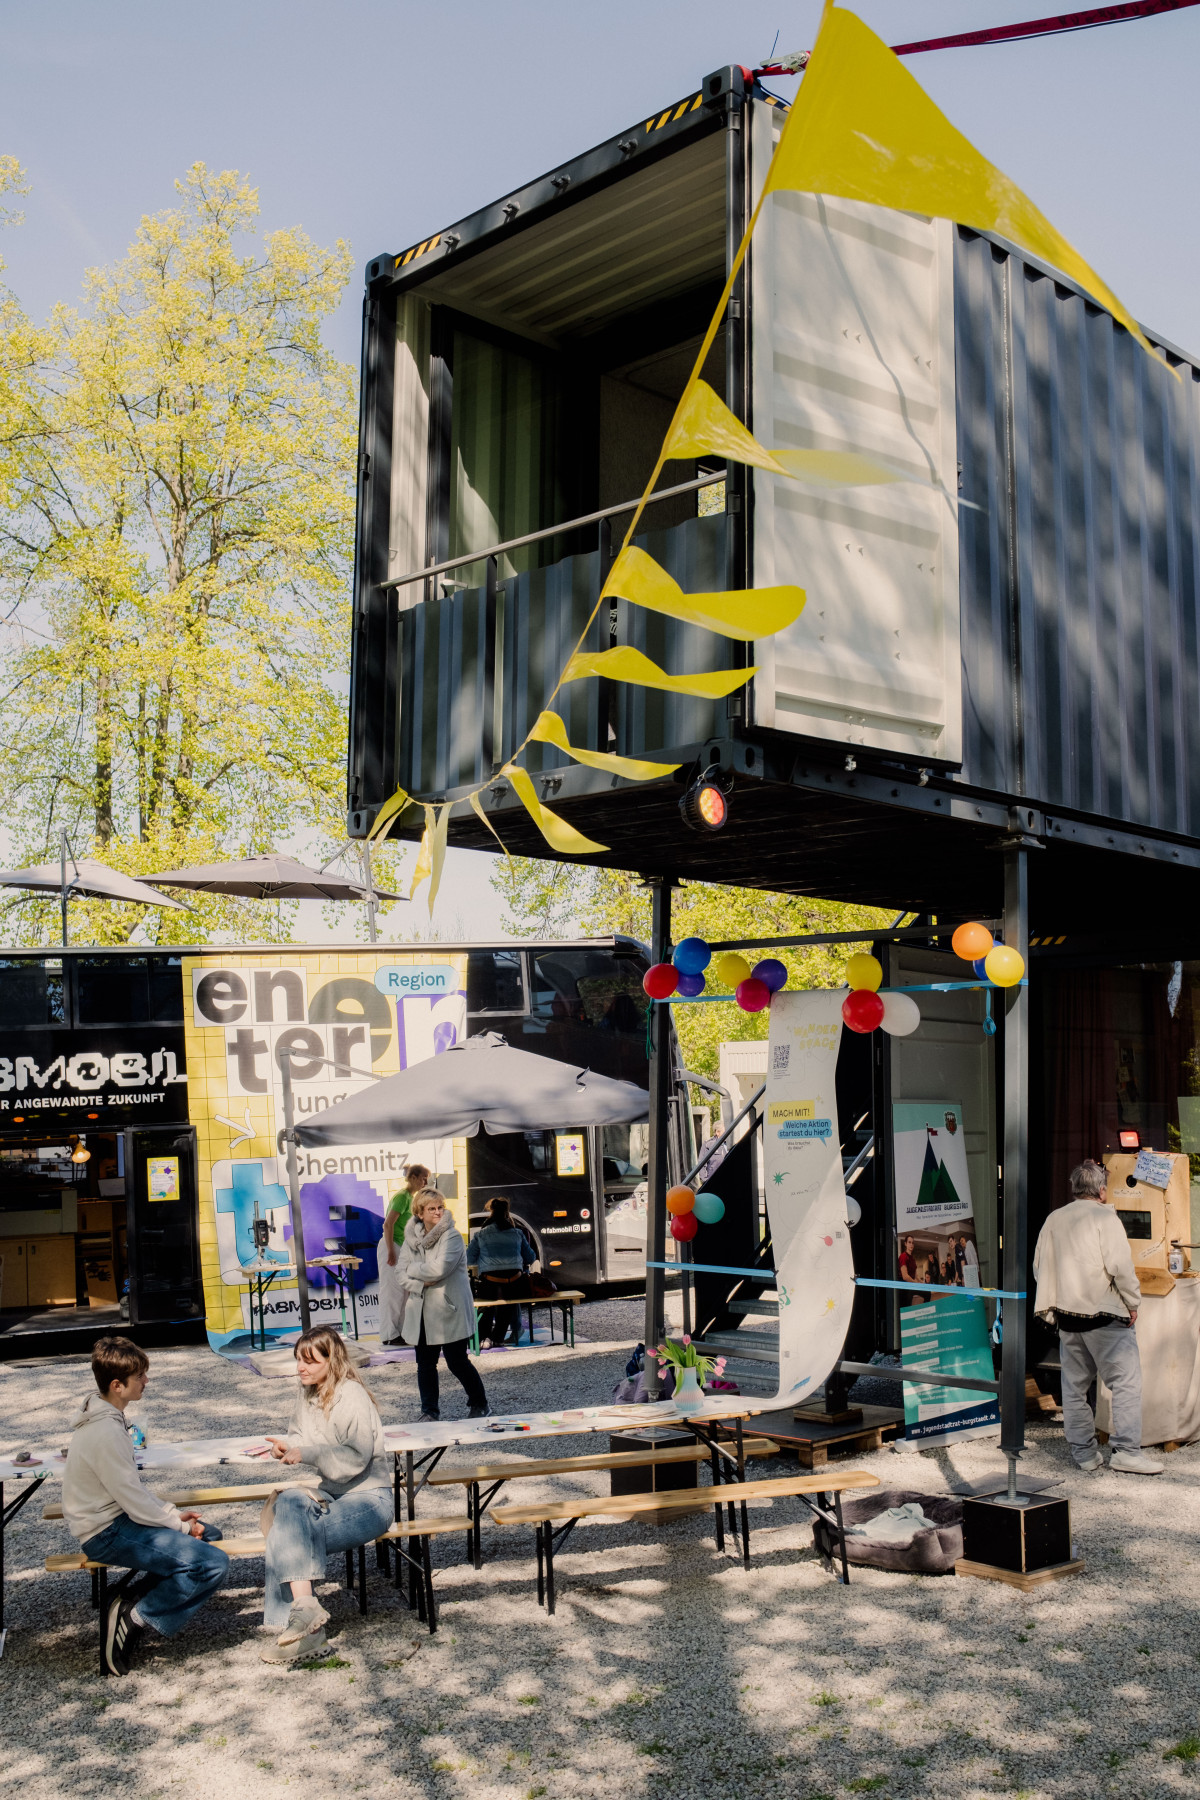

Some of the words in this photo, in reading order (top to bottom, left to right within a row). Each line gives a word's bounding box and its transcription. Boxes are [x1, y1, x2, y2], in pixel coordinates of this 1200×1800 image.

[388, 972, 446, 991] Region
[196, 970, 304, 1023] en
[793, 1024, 839, 1039] WANDER
[228, 1026, 366, 1094] ter
[14, 1096, 104, 1109] ANGEWANDTE
[107, 1093, 166, 1105] ZUKUNFT
[772, 1109, 794, 1118] MACH
[794, 1108, 810, 1117] MIT!
[785, 1121, 808, 1129] Welche
[808, 1120, 829, 1128] Aktion
[779, 1130, 804, 1138] startest
[813, 1128, 830, 1136] hier?
[286, 1149, 410, 1177] Chemnitz
[541, 1226, 572, 1234] @fabmobil
[911, 1413, 996, 1434] www.jugendstadtrat-burgstaedt.de
